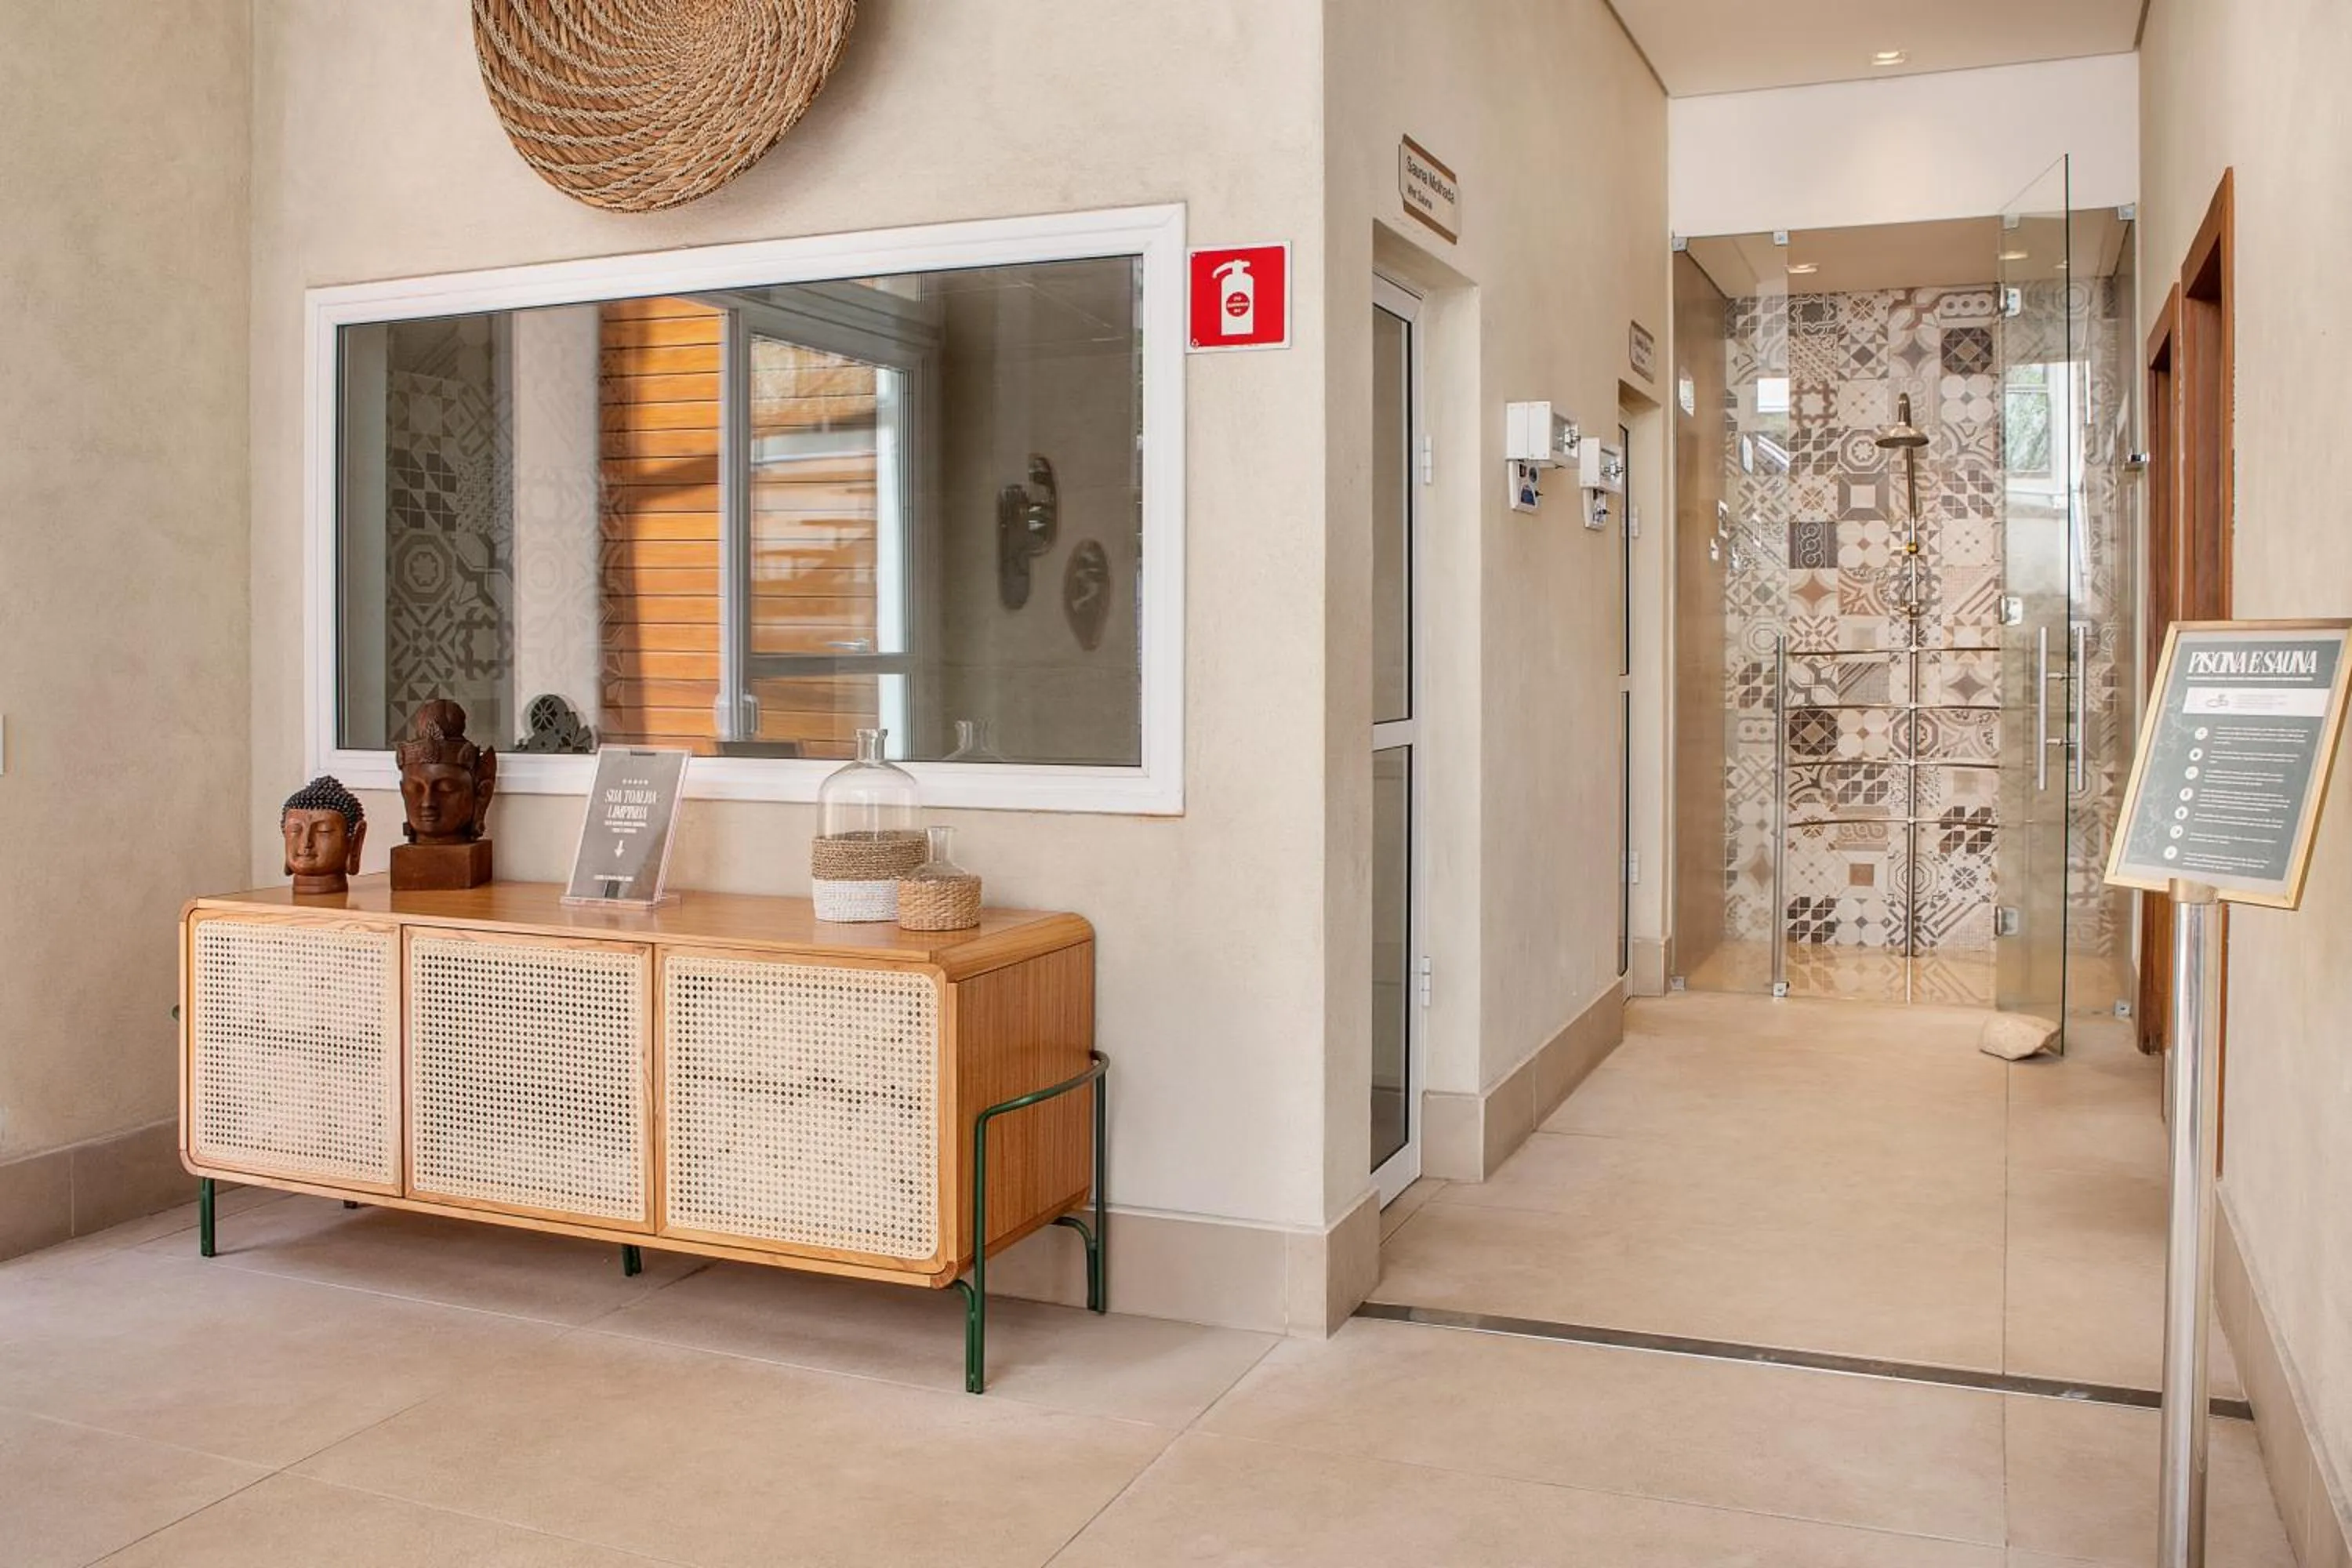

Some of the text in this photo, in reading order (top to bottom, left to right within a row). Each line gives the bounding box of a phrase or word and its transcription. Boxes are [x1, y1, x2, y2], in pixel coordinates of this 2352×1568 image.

[2187, 650, 2318, 673] PISCINA E SAUNA
